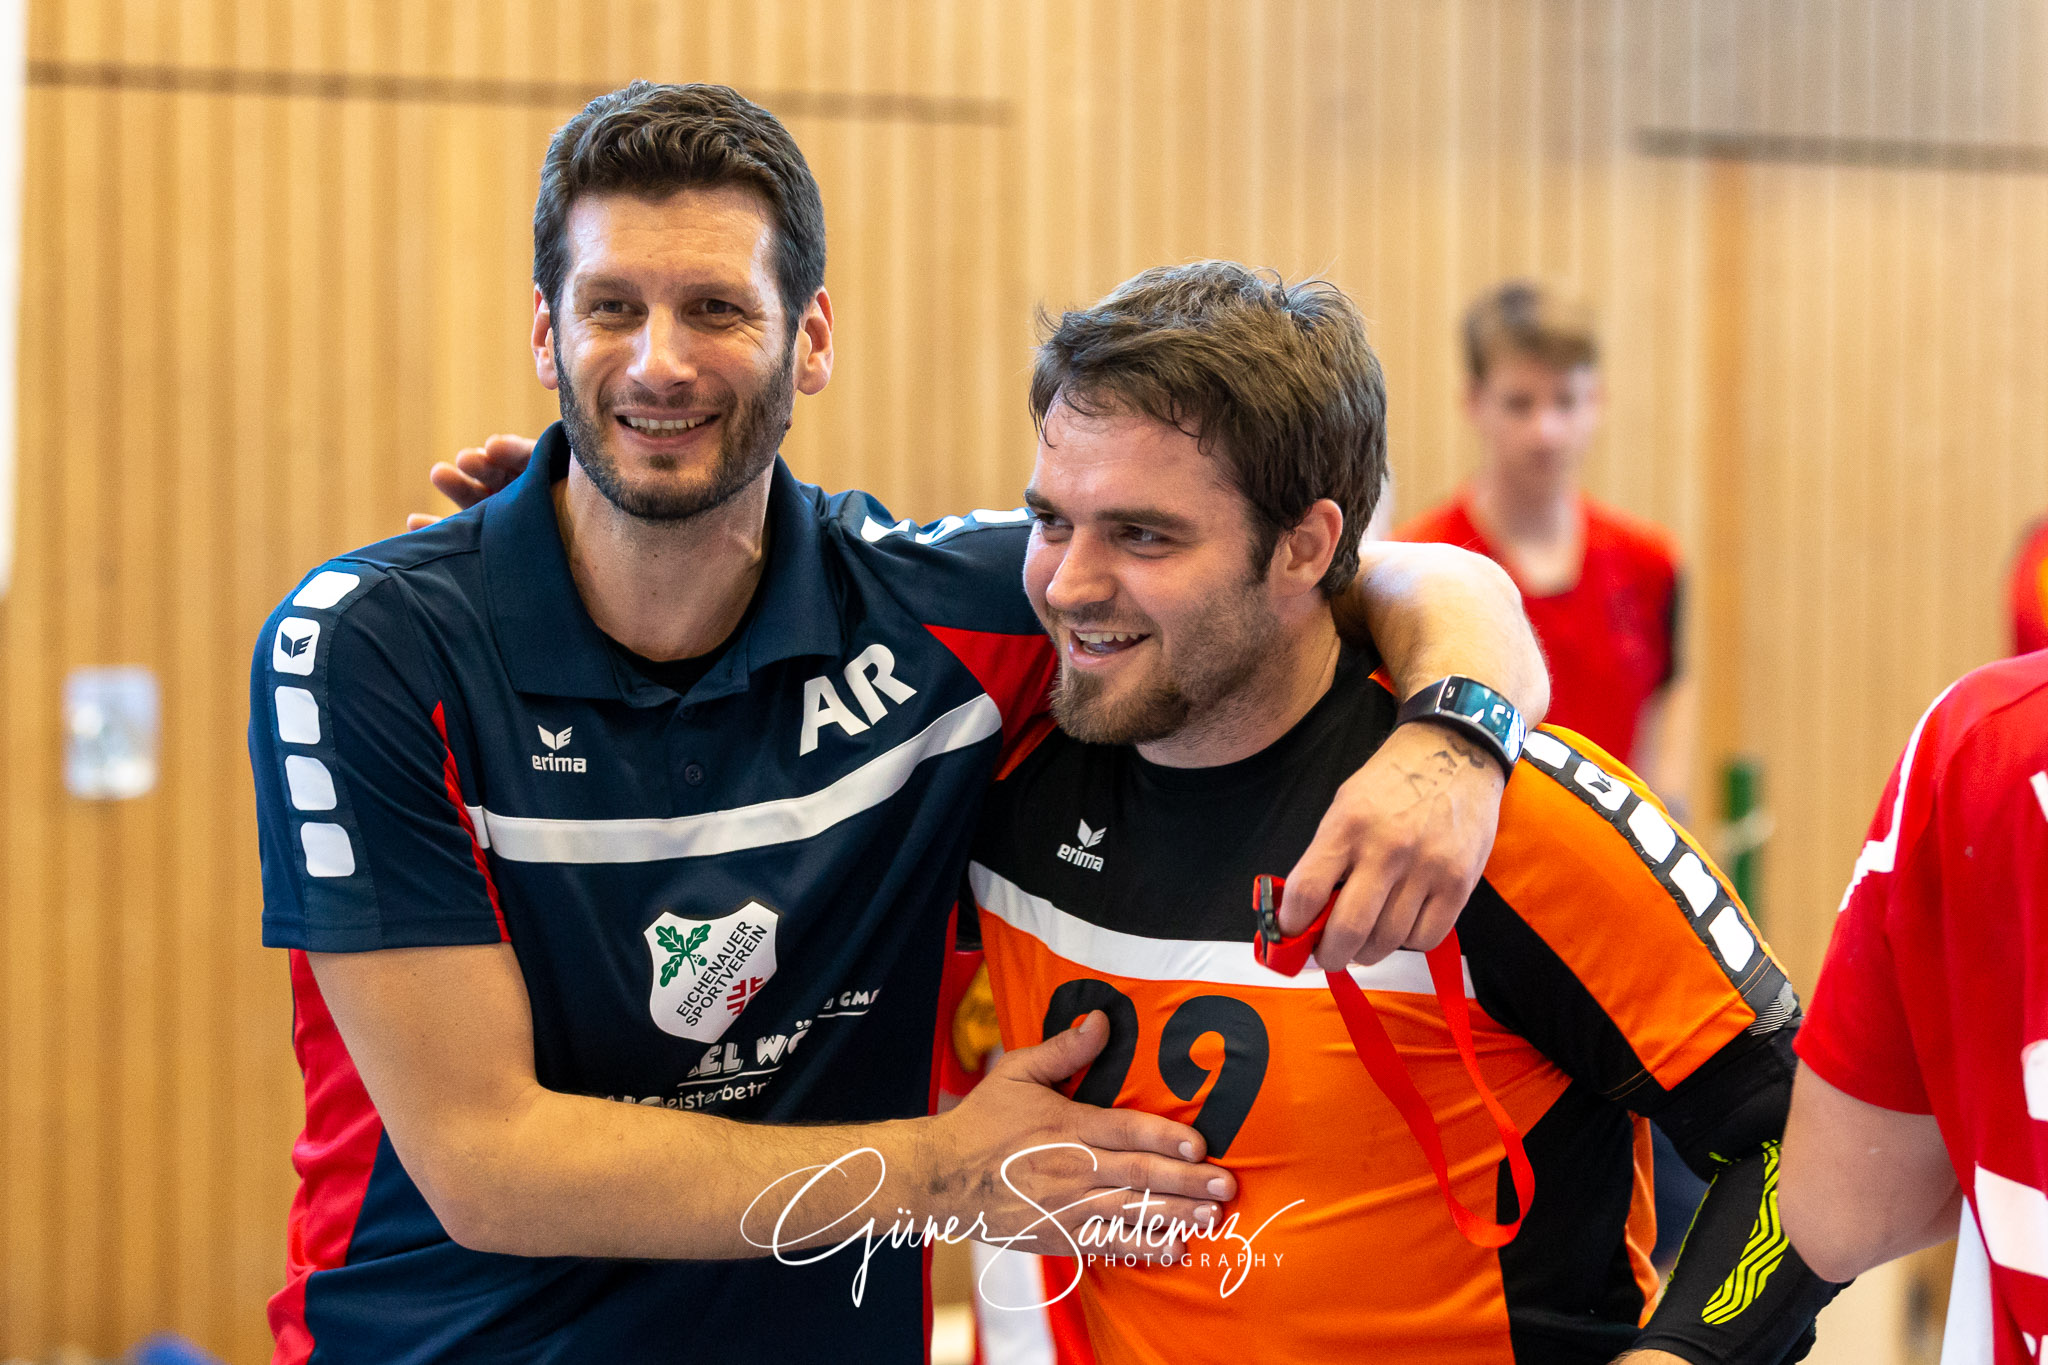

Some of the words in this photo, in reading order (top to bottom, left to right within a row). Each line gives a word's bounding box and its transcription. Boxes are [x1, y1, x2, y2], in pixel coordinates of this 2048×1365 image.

[799, 643, 918, 757] AR
[531, 752, 587, 774] erima
[1056, 842, 1105, 873] erima
[675, 921, 753, 1018] EICHENAUER
[685, 924, 768, 1027] SPORTVEREIN
